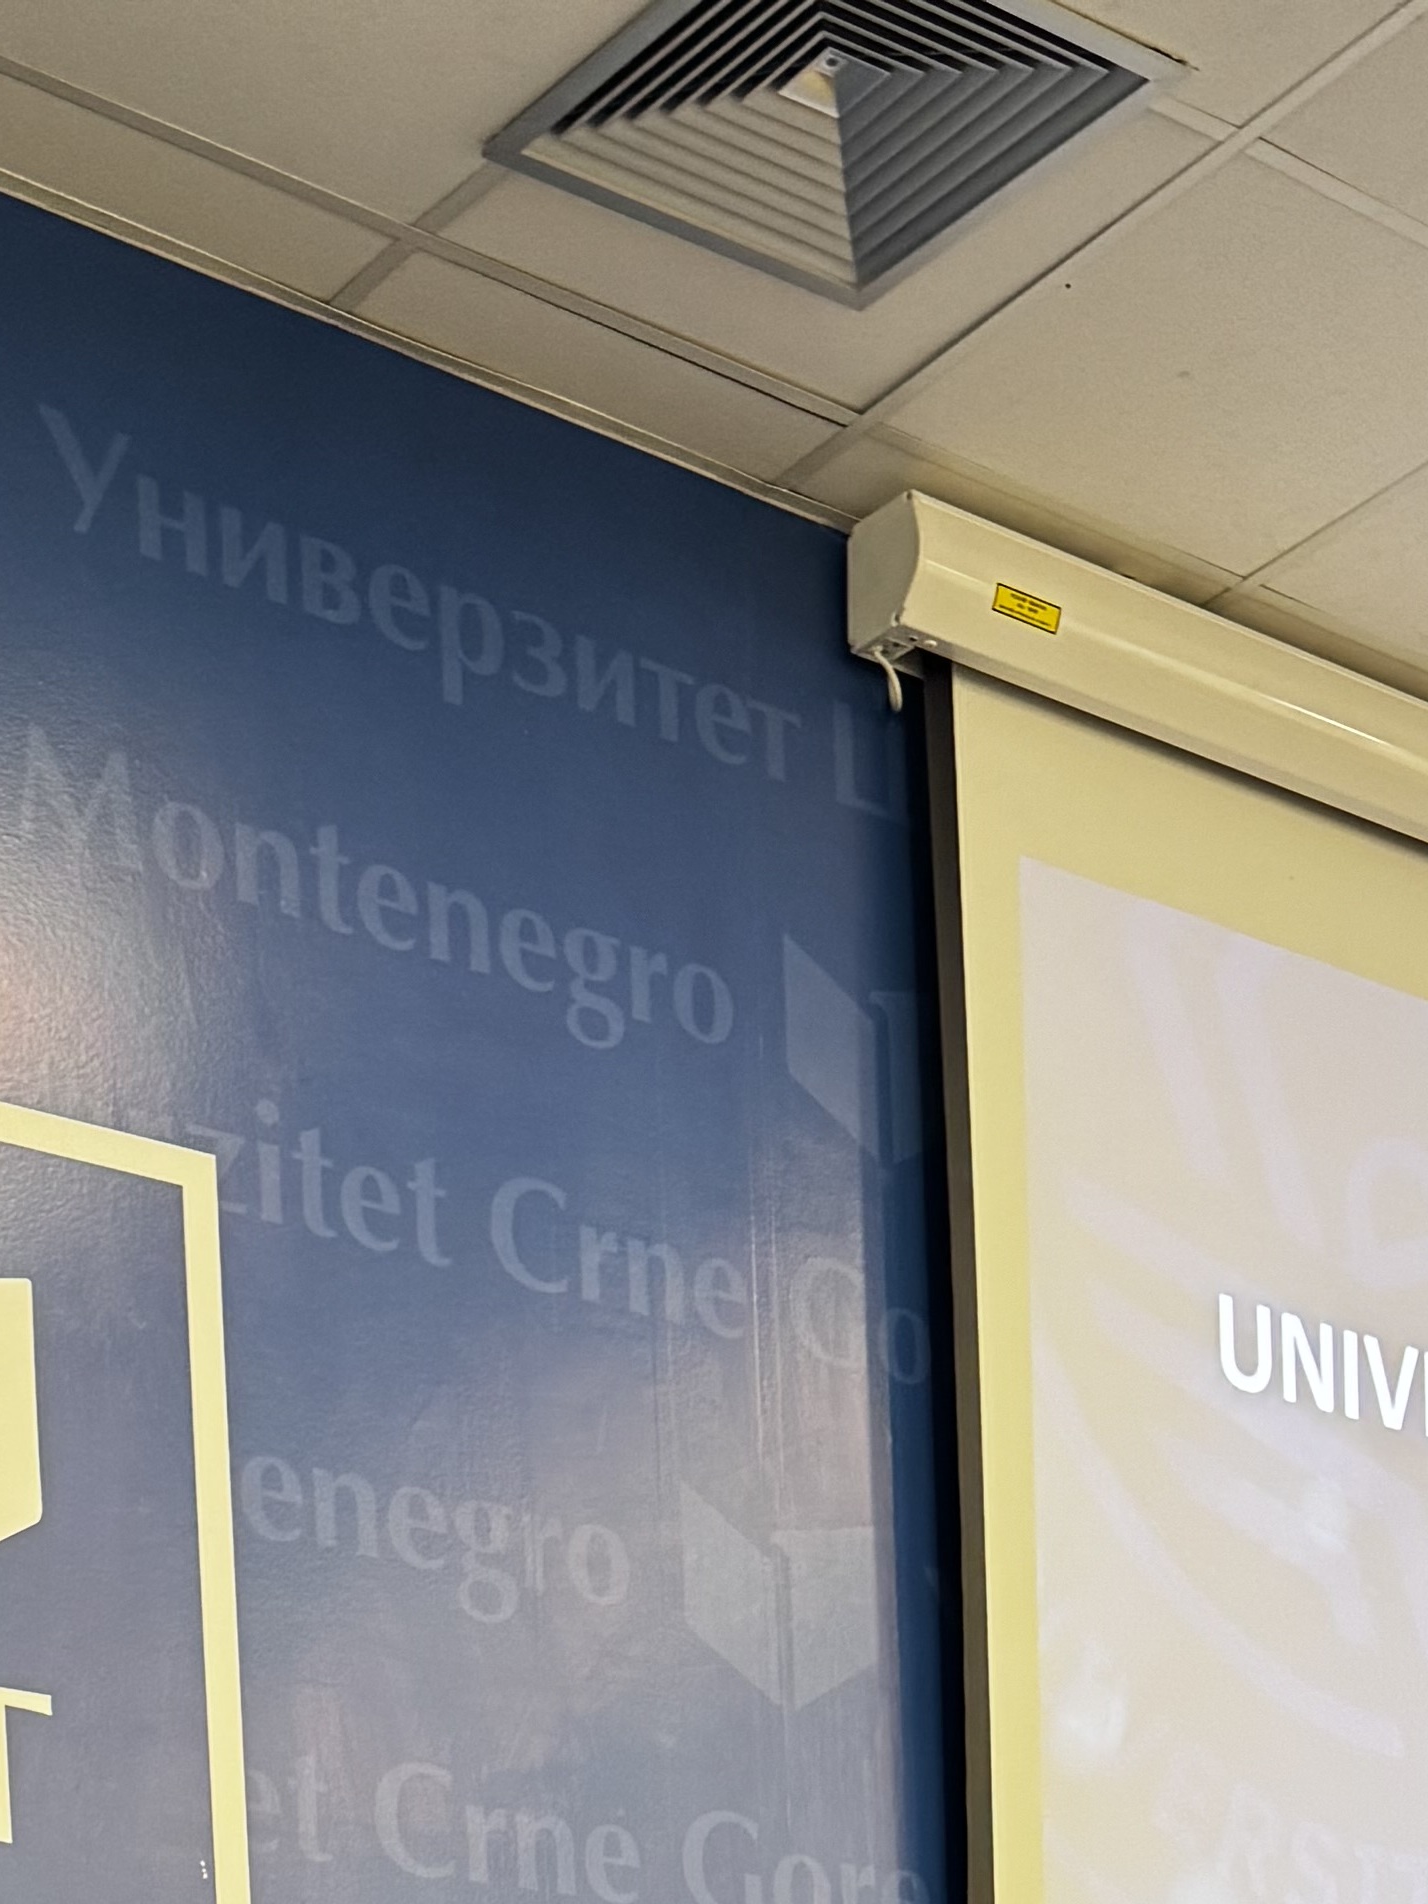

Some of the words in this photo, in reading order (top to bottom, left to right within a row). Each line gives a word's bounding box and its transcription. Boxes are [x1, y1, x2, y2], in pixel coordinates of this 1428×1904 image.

[38, 401, 803, 781] Универзитет
[21, 723, 735, 1049] Montenegro
[489, 1175, 750, 1339] Crne
